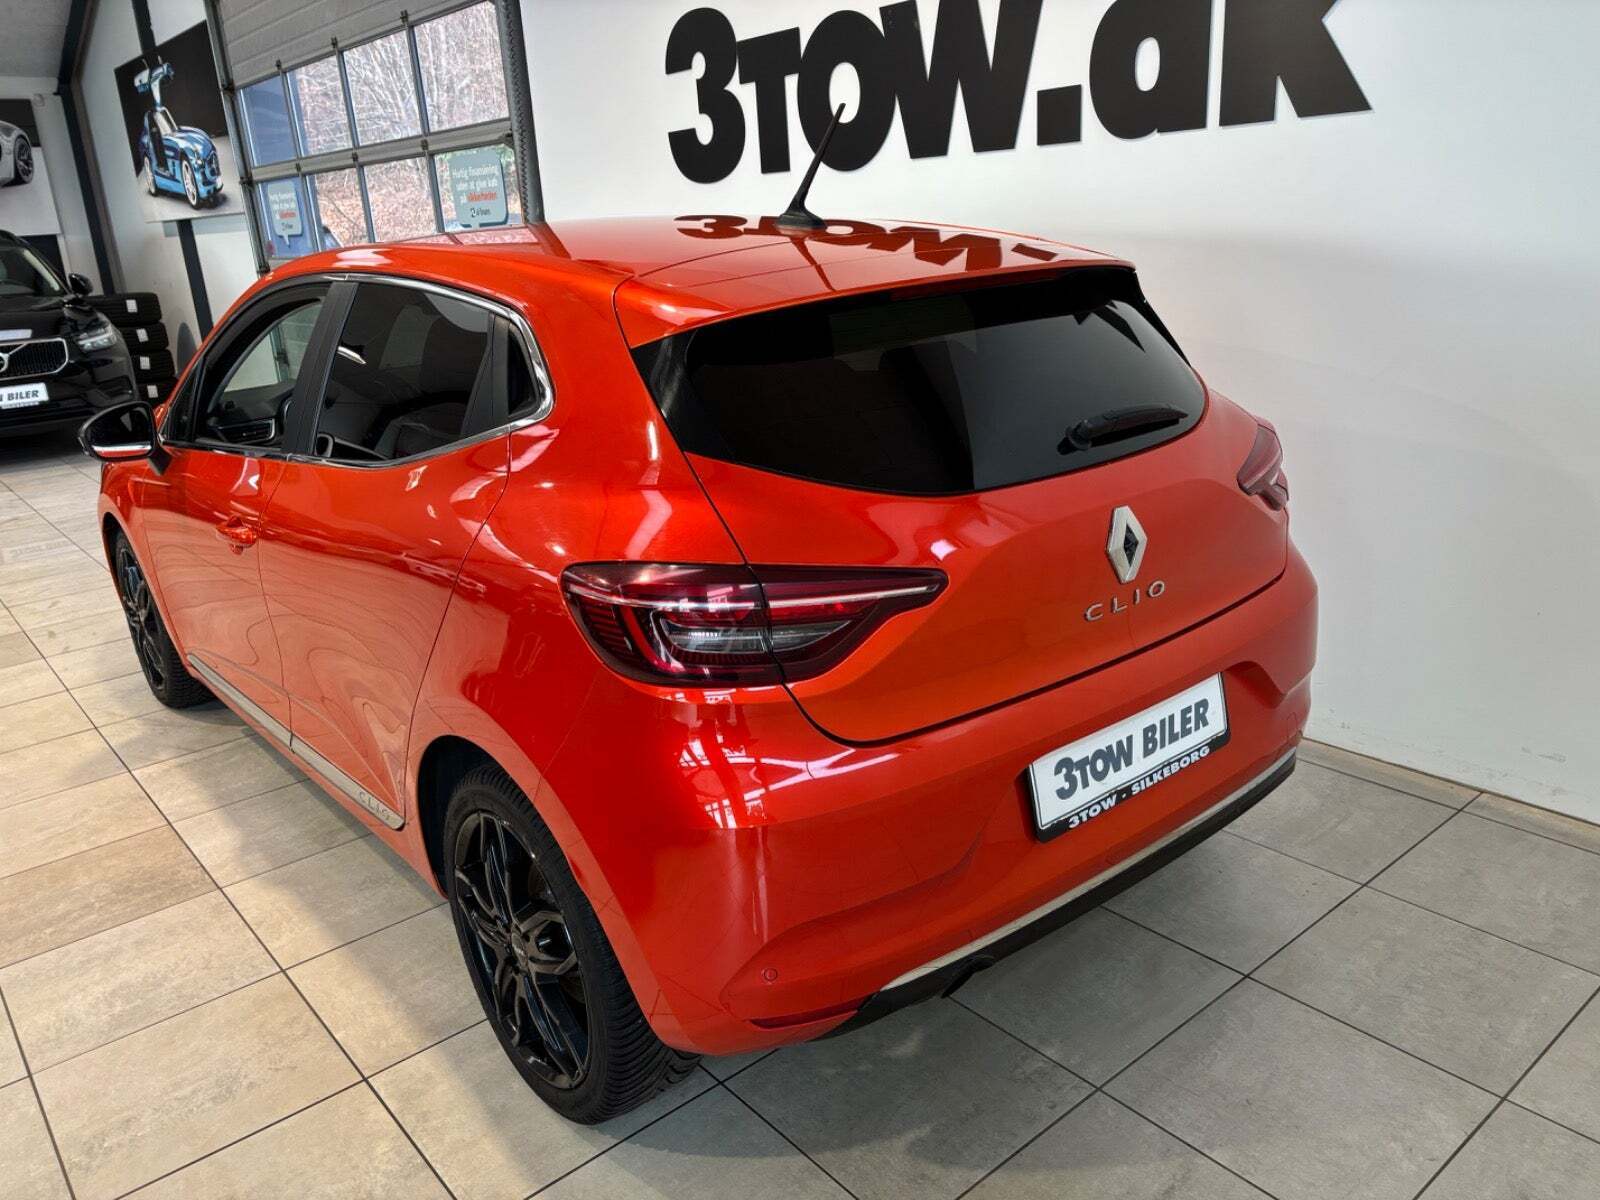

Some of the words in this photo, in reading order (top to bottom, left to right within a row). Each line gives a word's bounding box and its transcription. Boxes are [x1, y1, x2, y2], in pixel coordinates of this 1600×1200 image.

[8, 390, 39, 401] BILER
[1084, 580, 1165, 621] CLIO
[1054, 734, 1134, 801] 3TOW
[1142, 698, 1210, 759] BILER
[1068, 792, 1117, 828] 3TOW
[1131, 746, 1210, 796] SILKEBORG
